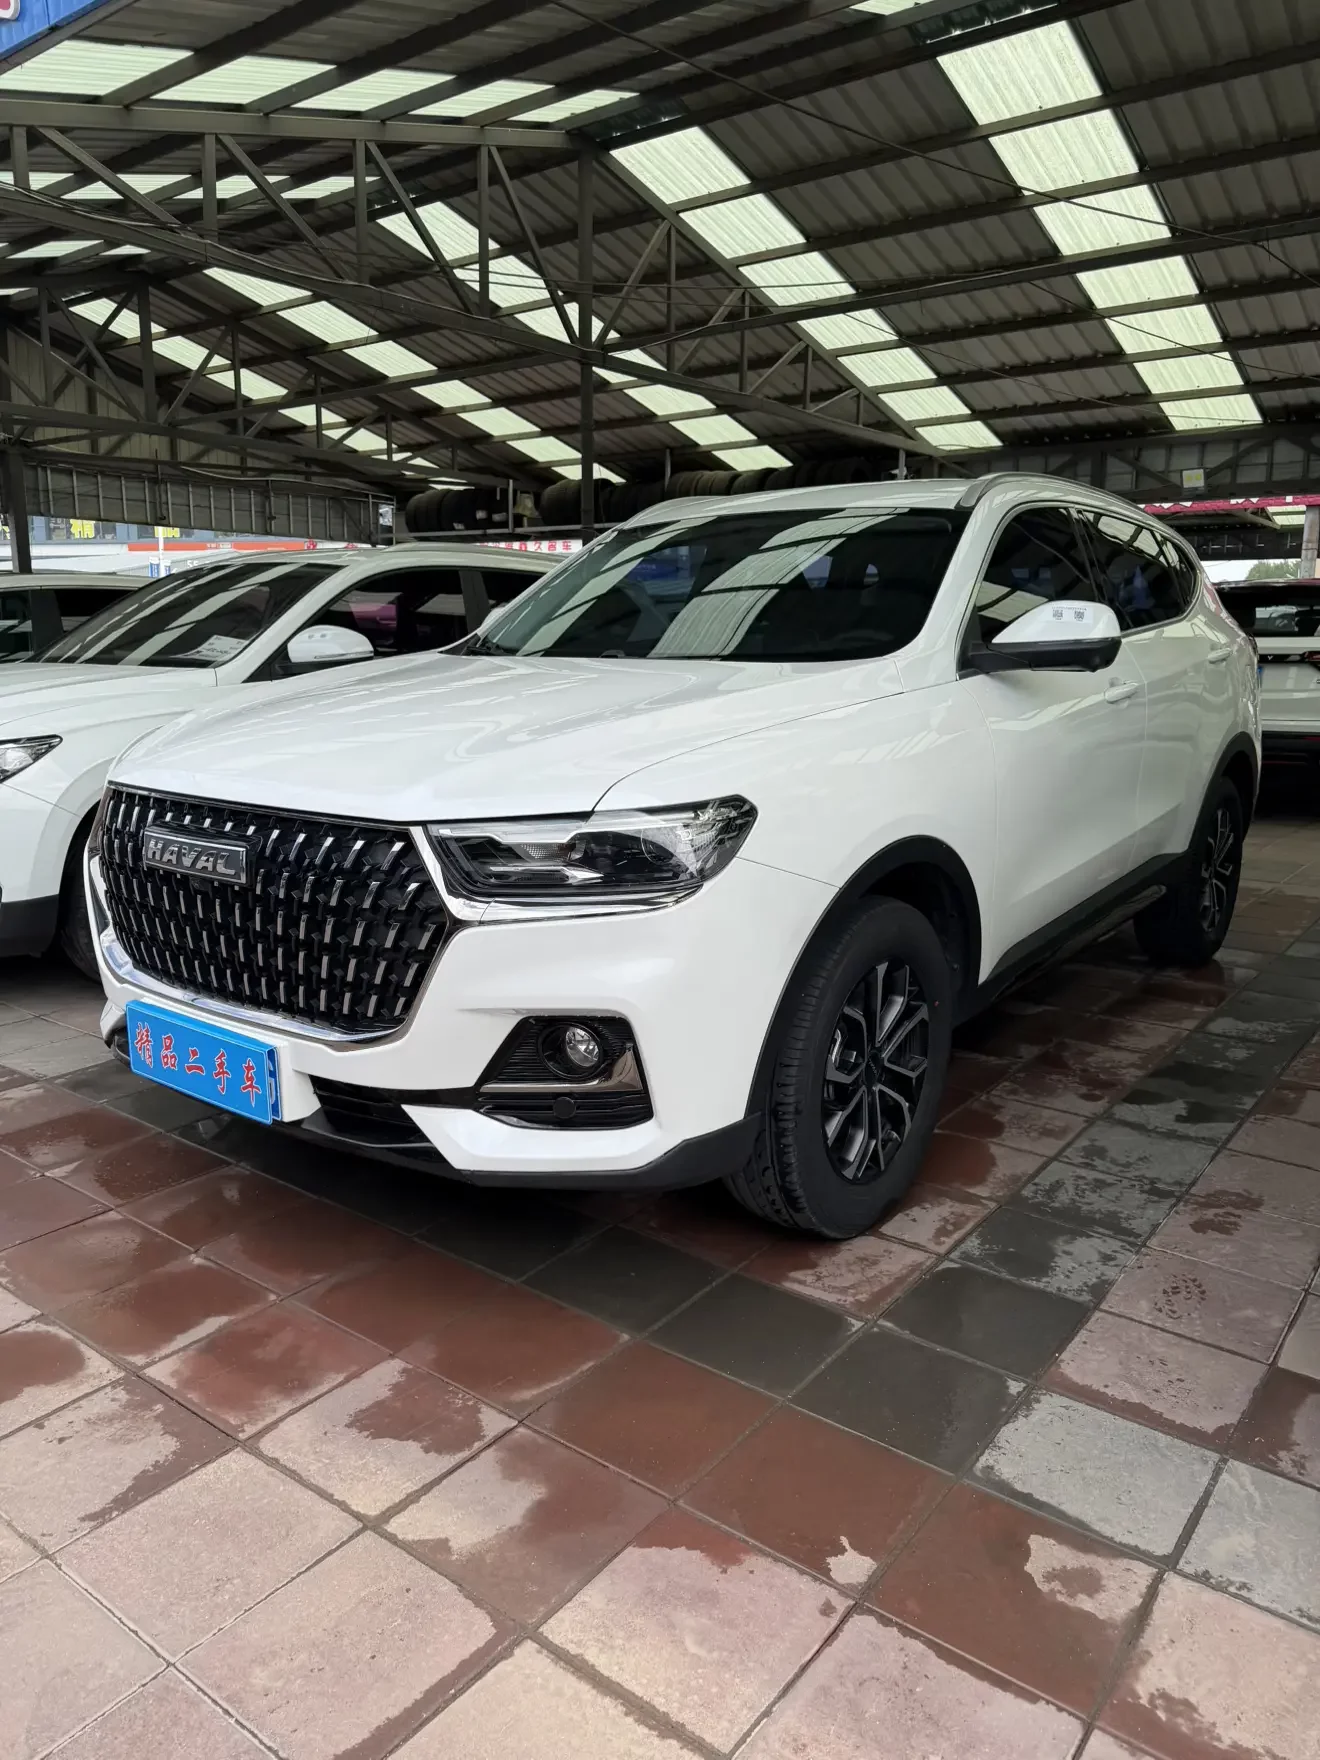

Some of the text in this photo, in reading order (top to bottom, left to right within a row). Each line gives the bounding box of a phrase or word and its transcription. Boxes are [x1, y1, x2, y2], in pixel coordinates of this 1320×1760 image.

[147, 838, 236, 876] HAVAL
[134, 1021, 262, 1108] 精品二手车
